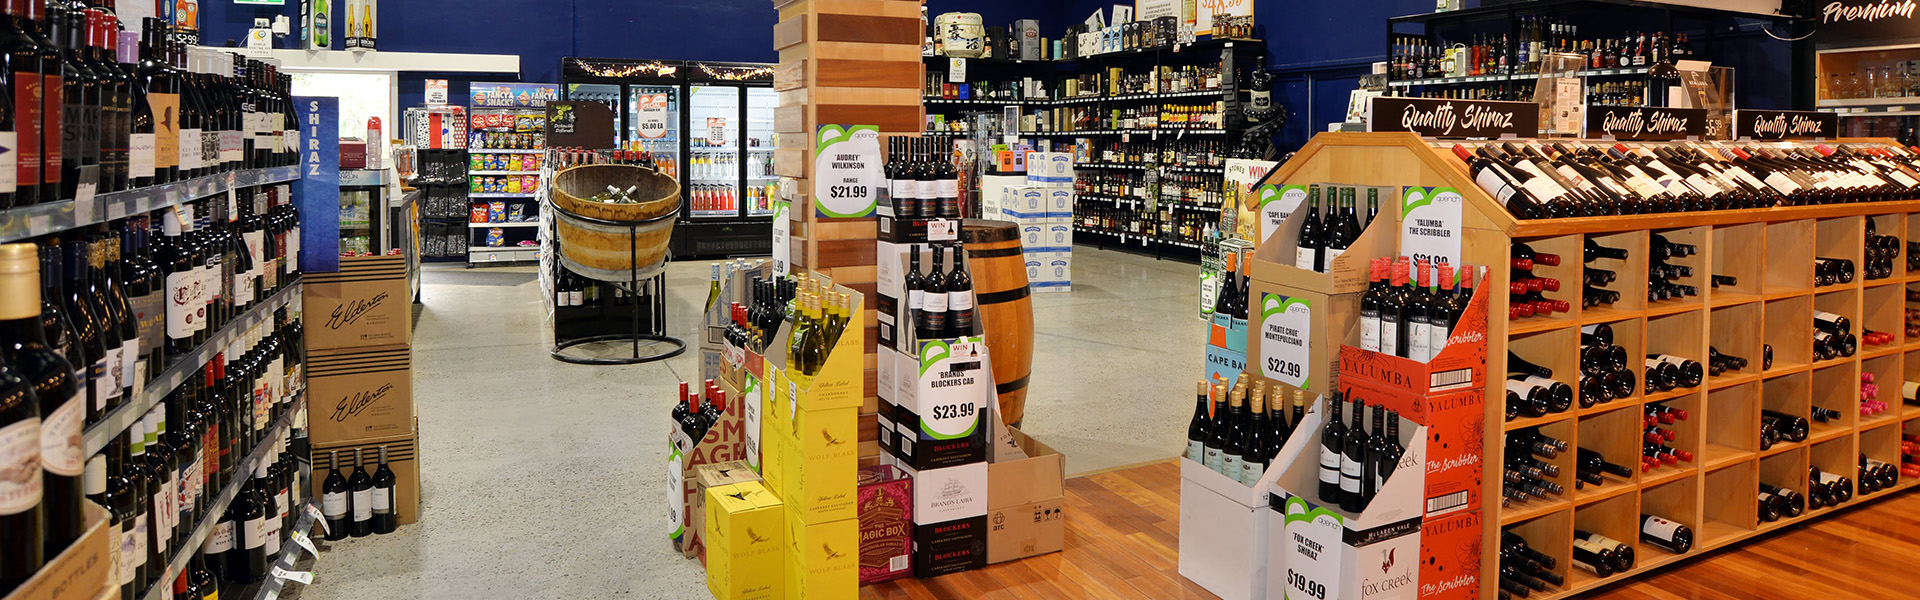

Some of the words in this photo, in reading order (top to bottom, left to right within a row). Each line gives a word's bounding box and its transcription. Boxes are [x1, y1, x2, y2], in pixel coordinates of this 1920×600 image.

[1823, 0, 1917, 24] Premium
[1401, 101, 1457, 136] Quality
[1461, 103, 1514, 132] Shiraz
[1602, 108, 1644, 138] Quality
[1646, 111, 1688, 137] Shiraz
[1753, 112, 1788, 138] Quality
[1789, 115, 1822, 137] Shiraz
[308, 100, 321, 176] SHIRAZ
[831, 162, 865, 170] WILKINSON
[830, 185, 868, 199] $21.99
[1409, 226, 1419, 235] THE
[1419, 228, 1451, 238] SCRIBBLER
[324, 291, 389, 330] Elderton
[1264, 331, 1303, 347] MONTEPULCIANO
[1208, 353, 1229, 367] CAPE
[1267, 356, 1301, 378] $22.99
[931, 378, 962, 389] BLOCKERS
[962, 377, 975, 386] CAB
[1343, 358, 1413, 390] YALUMBA
[329, 382, 394, 423] Elderton
[933, 402, 974, 422] $23.99
[1429, 394, 1482, 413] YALUMBA
[933, 442, 970, 452] BLOCKERS
[886, 523, 906, 536] BOX
[934, 523, 971, 534] BLOCKERS
[993, 524, 1005, 532] arc
[1424, 516, 1479, 537] YALUMBA
[934, 549, 970, 560] BLOCKERS
[1297, 544, 1318, 561] SHIRAZ
[1287, 567, 1326, 600] $19.99
